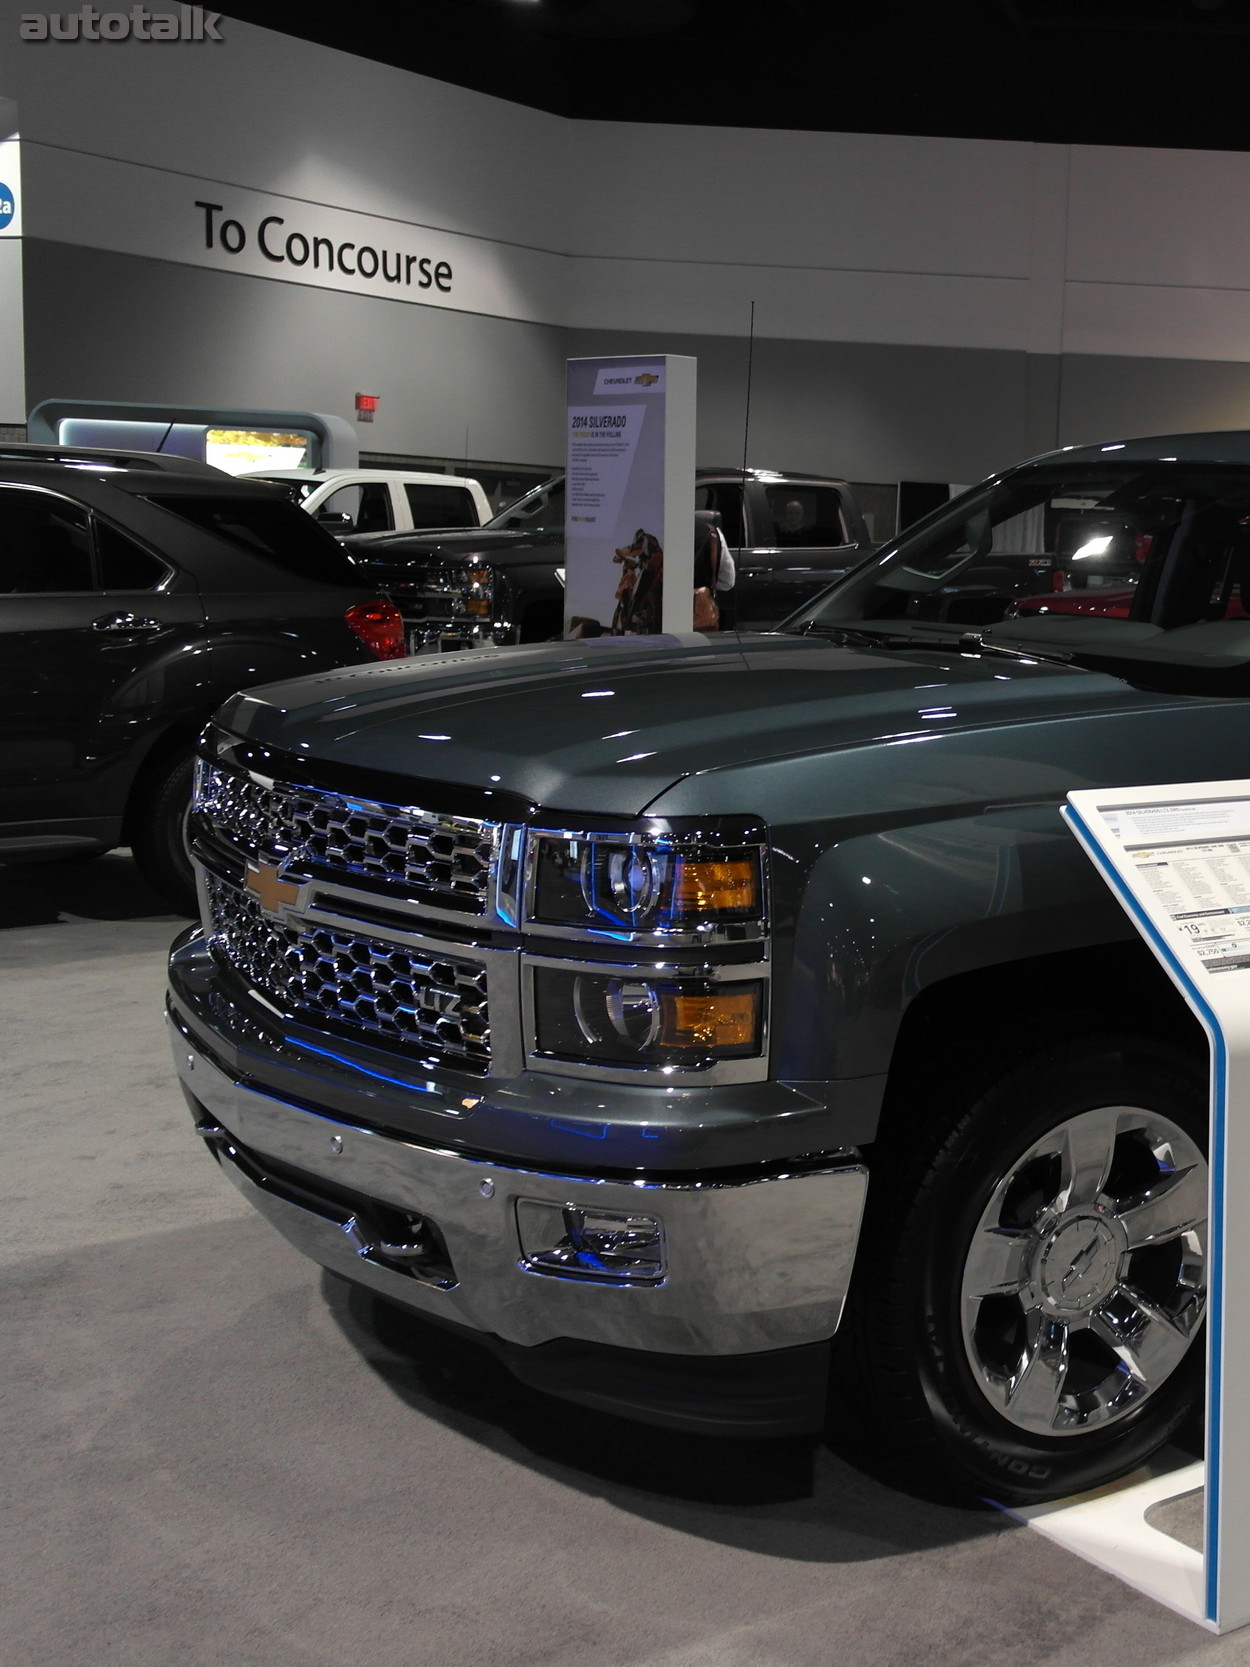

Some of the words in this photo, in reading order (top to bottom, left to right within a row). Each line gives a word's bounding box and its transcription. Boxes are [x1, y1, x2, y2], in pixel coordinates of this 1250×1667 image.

[195, 200, 246, 255] To
[257, 216, 453, 293] Concourse
[603, 377, 632, 385] CHEVROLET
[572, 416, 588, 429] 2014
[589, 415, 627, 428] SILVERADO
[1184, 924, 1201, 935] 19
[420, 986, 461, 1017] LTZ
